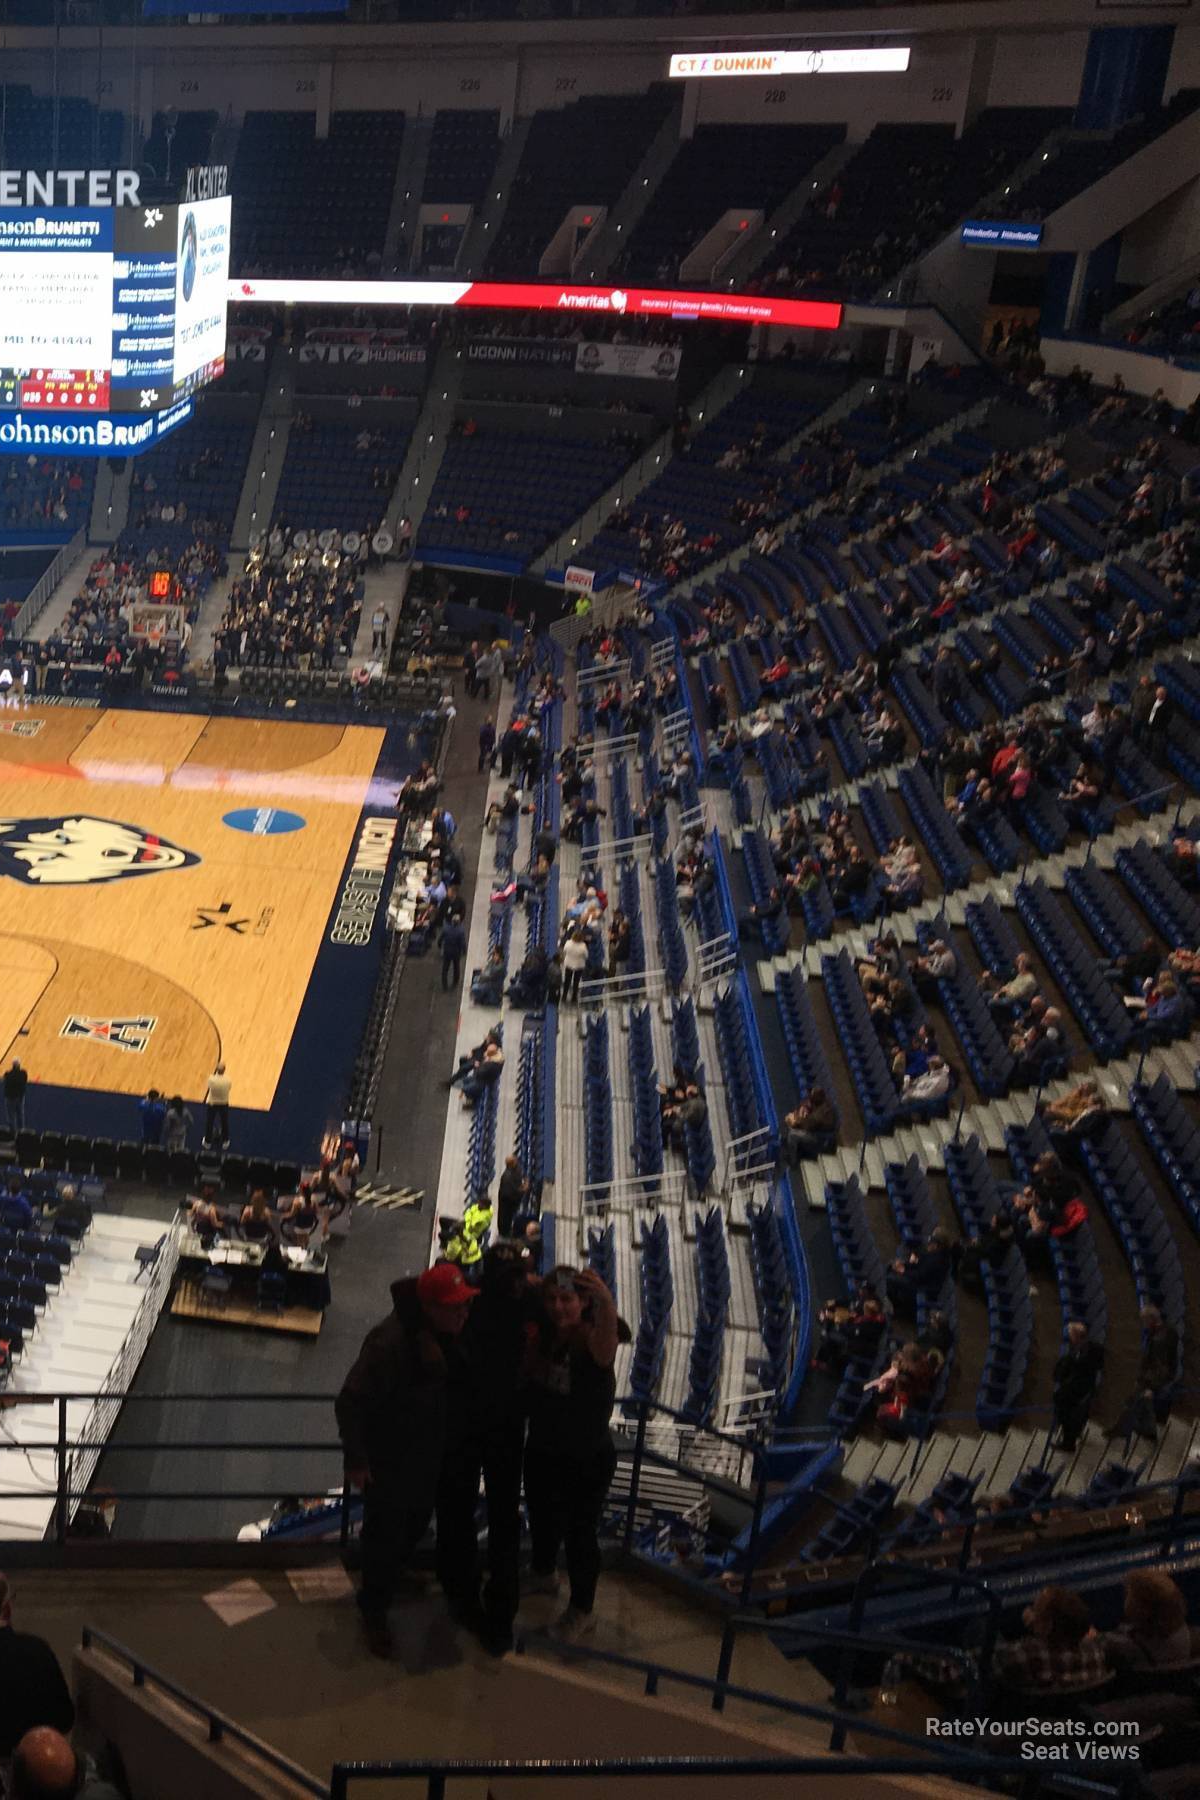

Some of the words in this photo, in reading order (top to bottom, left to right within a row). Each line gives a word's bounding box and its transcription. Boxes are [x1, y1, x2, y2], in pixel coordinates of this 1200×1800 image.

[714, 57, 777, 71] DUNKIN'
[198, 165, 228, 201] CENTER
[469, 345, 517, 360] UCONN
